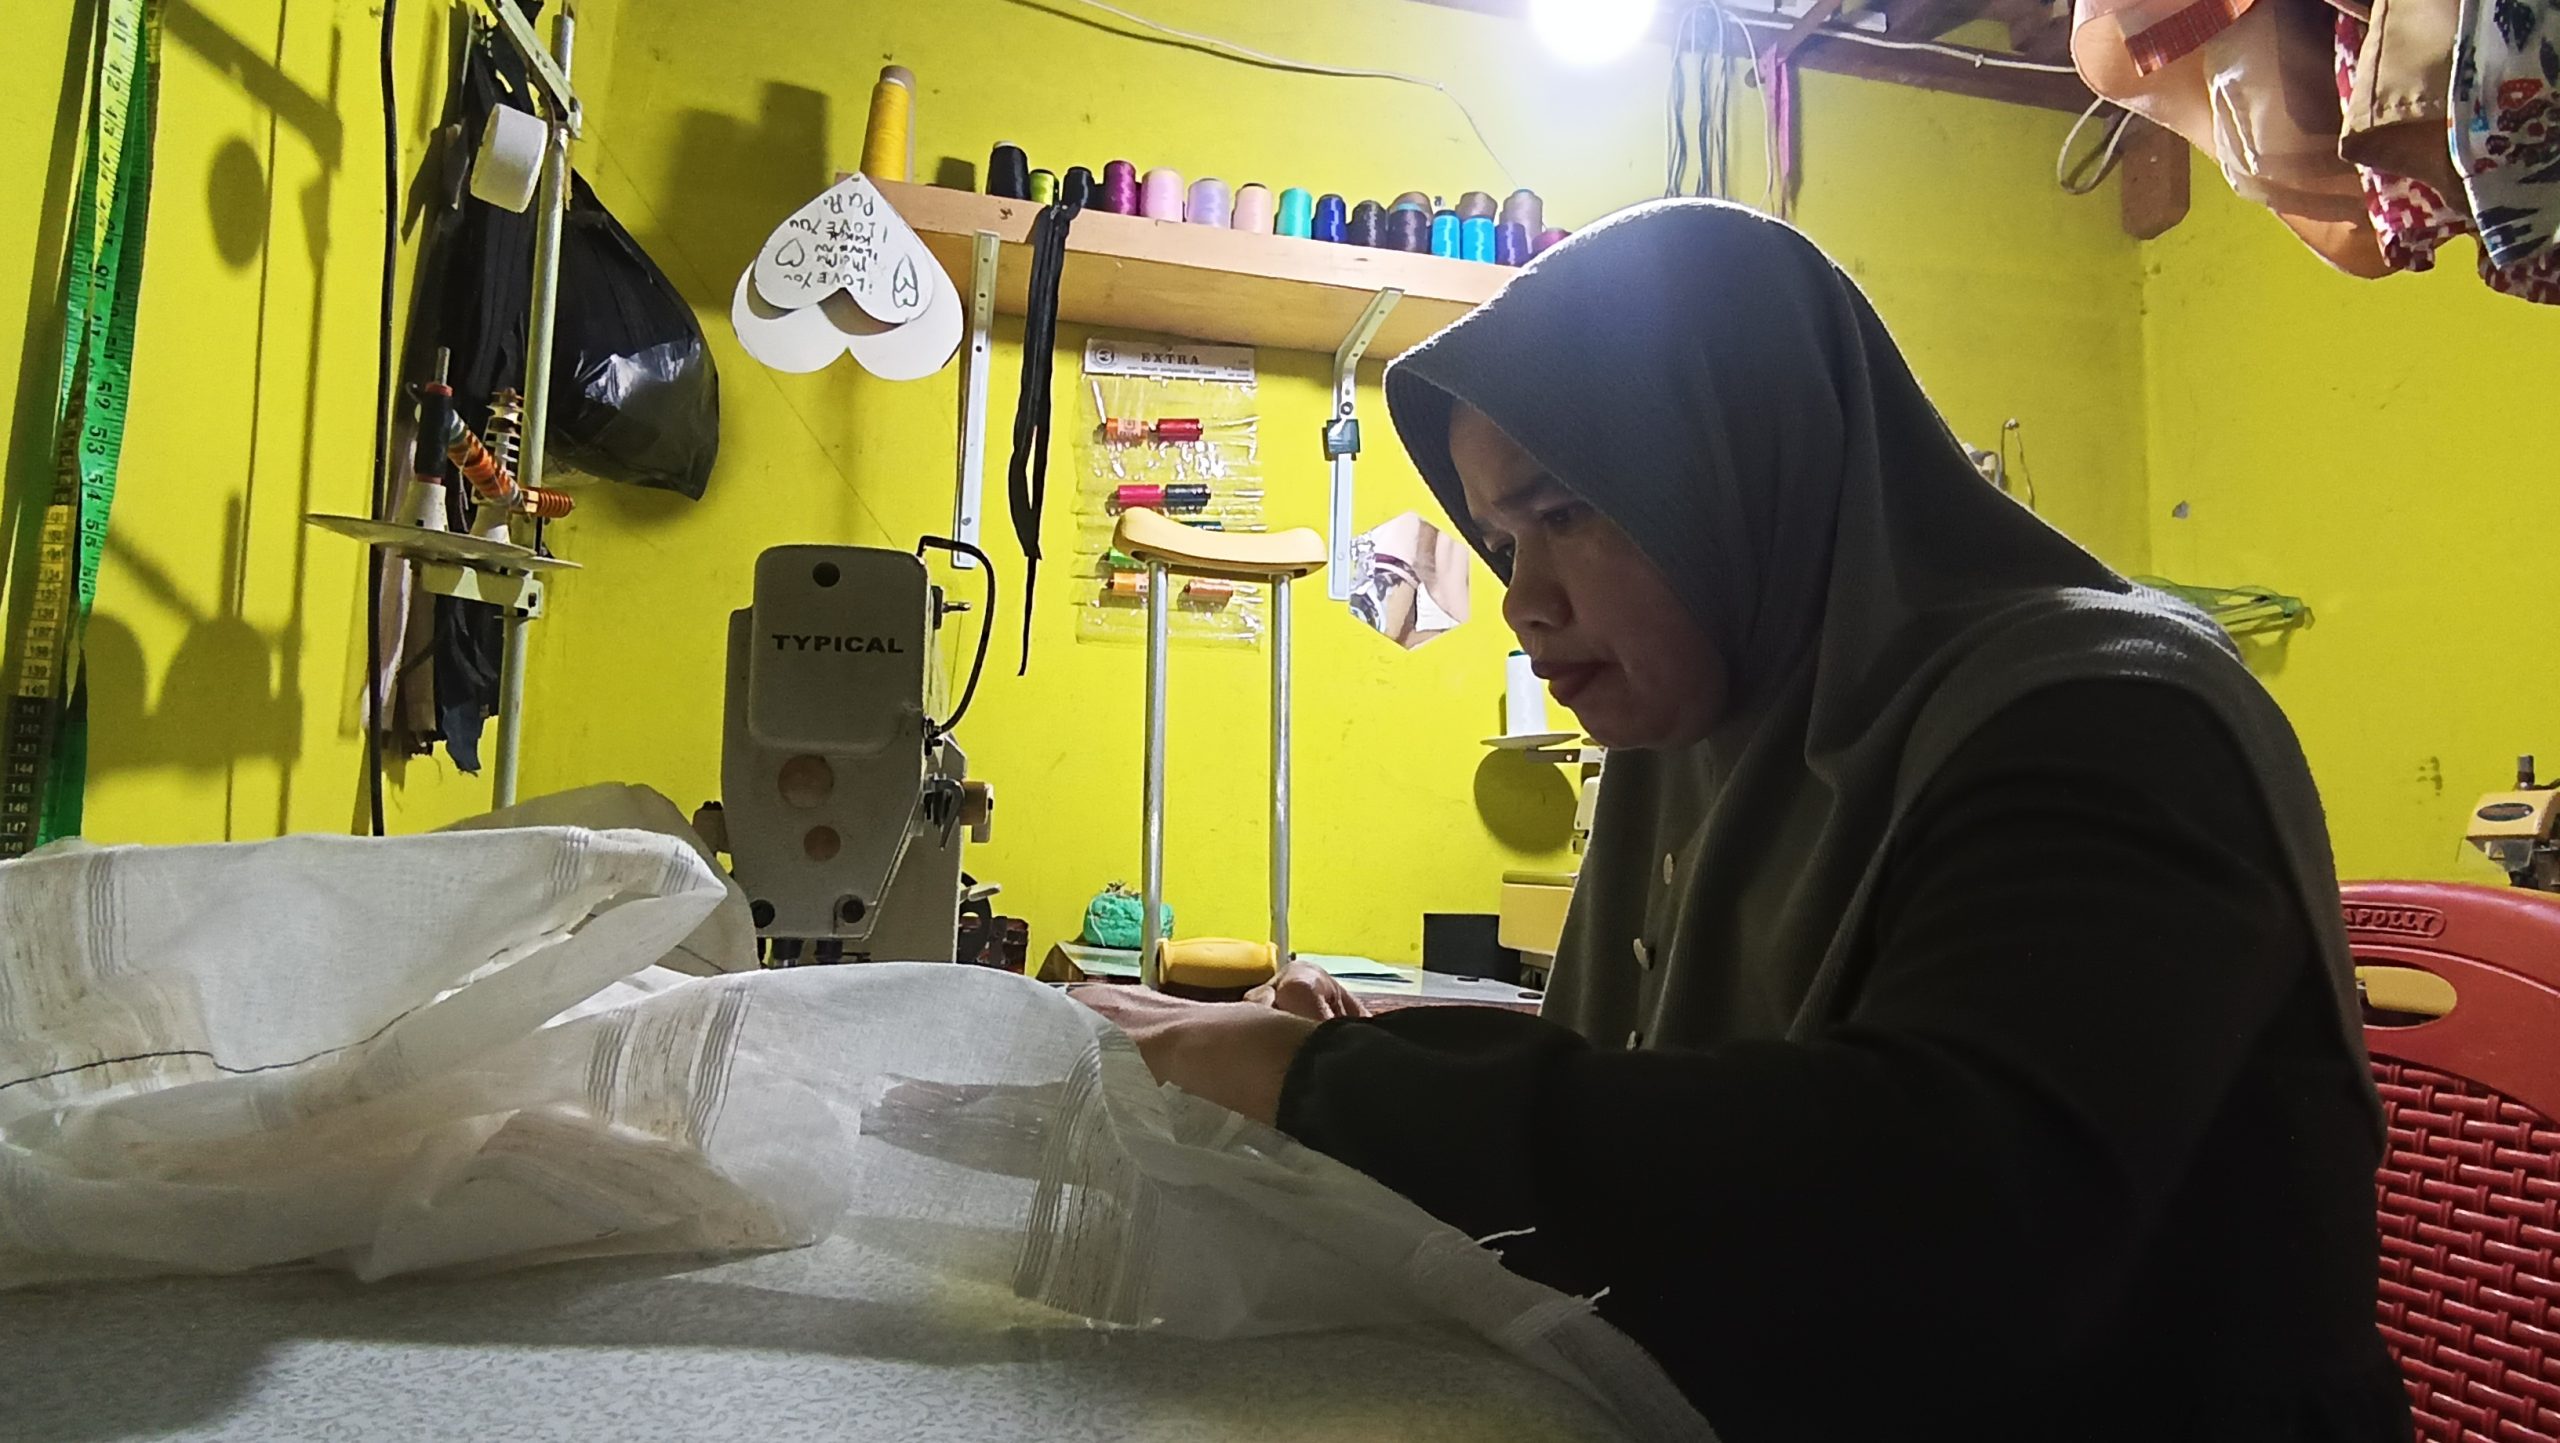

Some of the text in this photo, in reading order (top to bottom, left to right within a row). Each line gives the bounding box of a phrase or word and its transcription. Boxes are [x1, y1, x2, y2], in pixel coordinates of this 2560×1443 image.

[1140, 352, 1200, 365] EXTRA
[94, 381, 112, 410] 52
[87, 424, 108, 456] 53
[87, 470, 104, 502] 54
[84, 517, 100, 549] 55
[771, 634, 904, 654] TYPICAL
[14, 763, 34, 775] 144
[11, 783, 31, 794] 145
[8, 802, 28, 814] 146
[6, 821, 27, 834] 147
[2341, 907, 2436, 932] APOLLY
